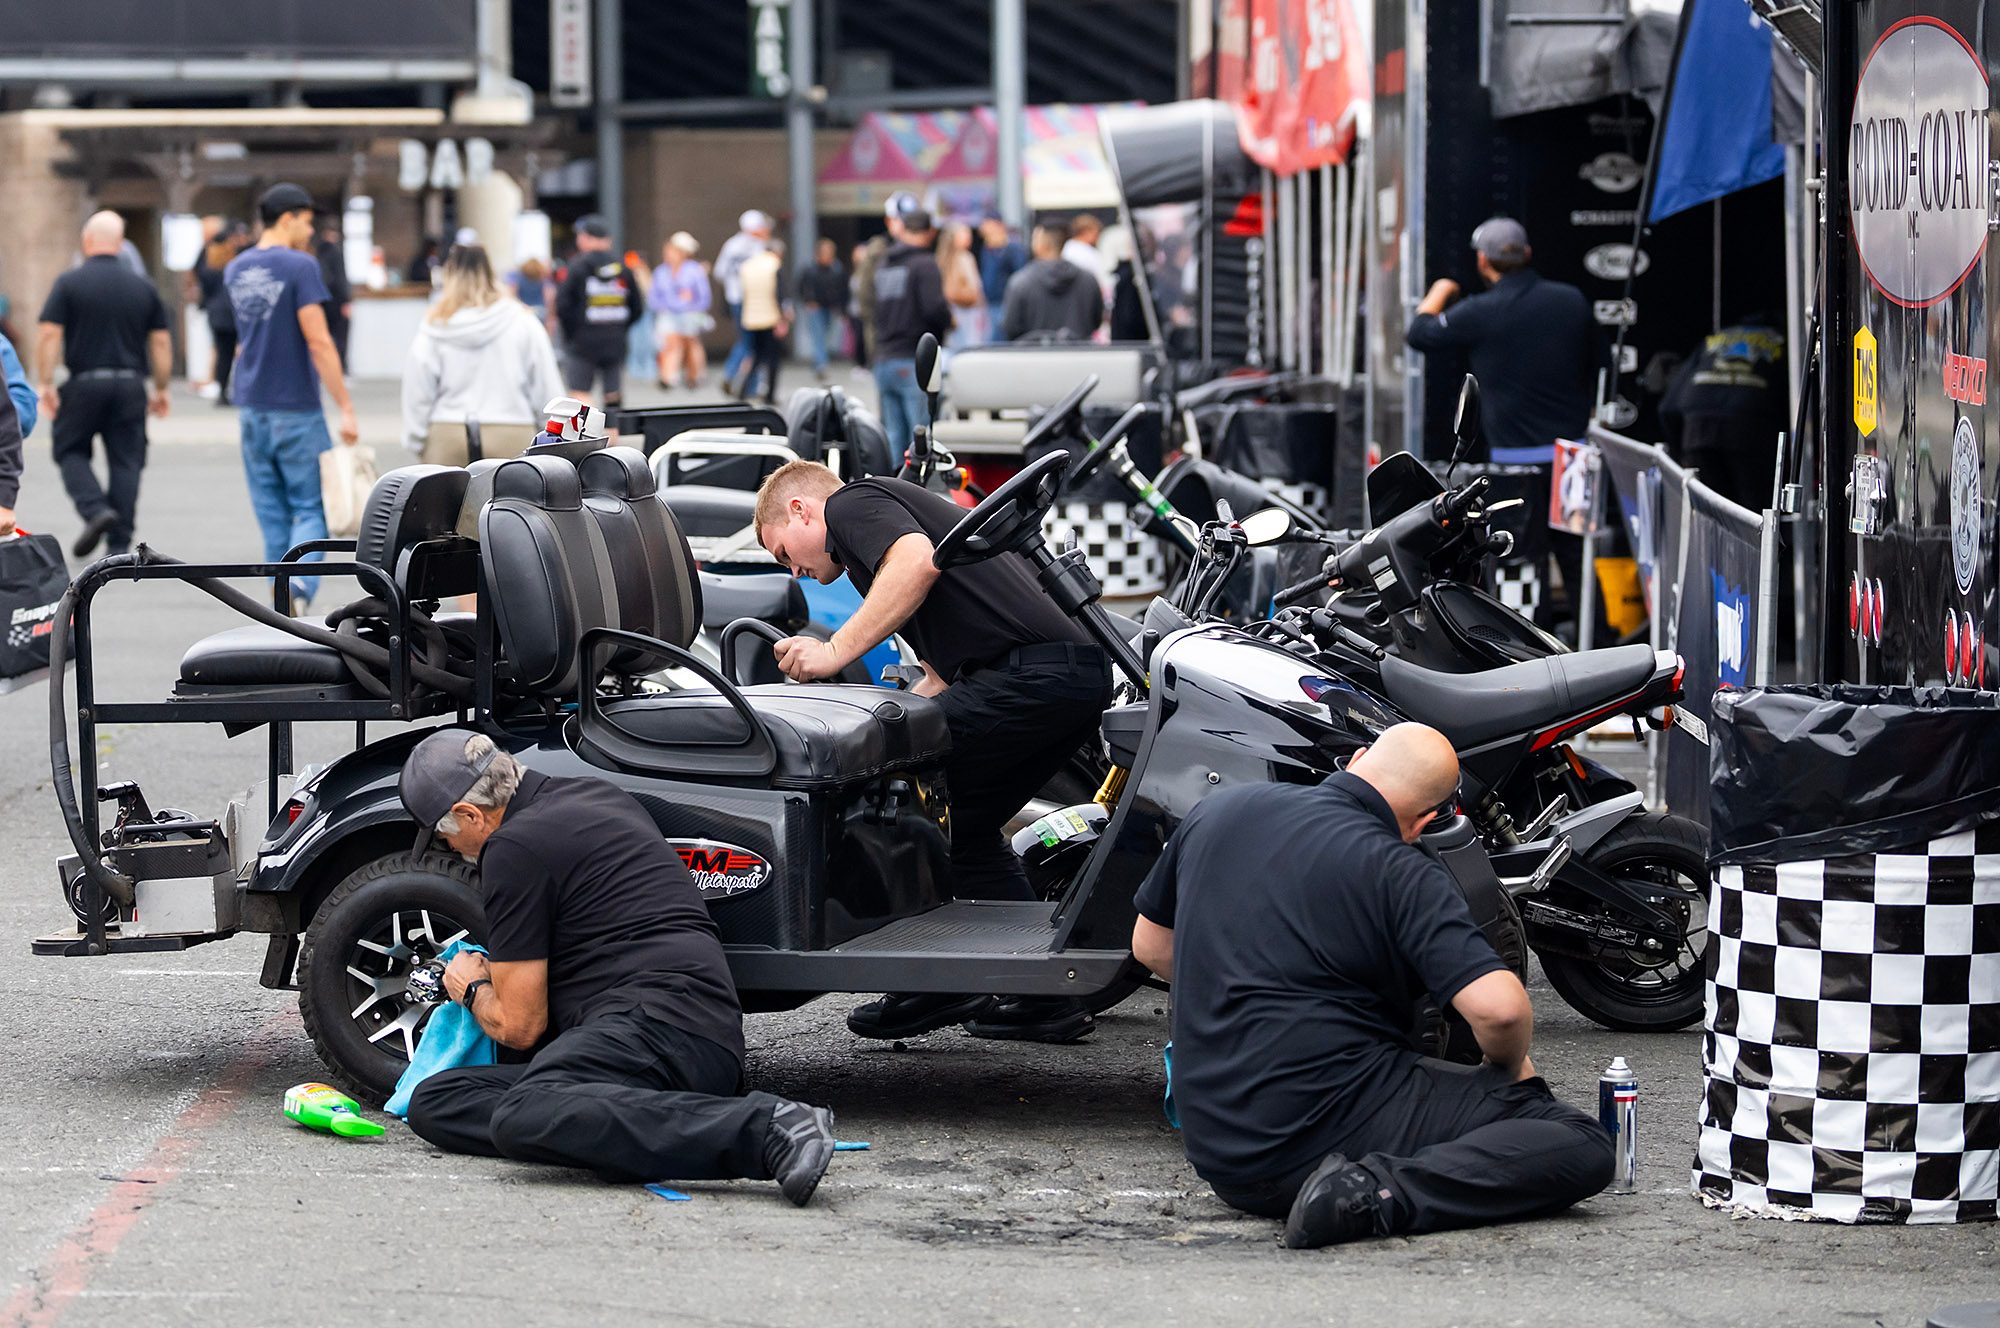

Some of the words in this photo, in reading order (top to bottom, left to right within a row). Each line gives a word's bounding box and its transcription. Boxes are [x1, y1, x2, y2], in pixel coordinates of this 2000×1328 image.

[398, 137, 495, 190] BAR
[1857, 348, 1874, 400] TMS
[689, 869, 763, 894] Motorsports
